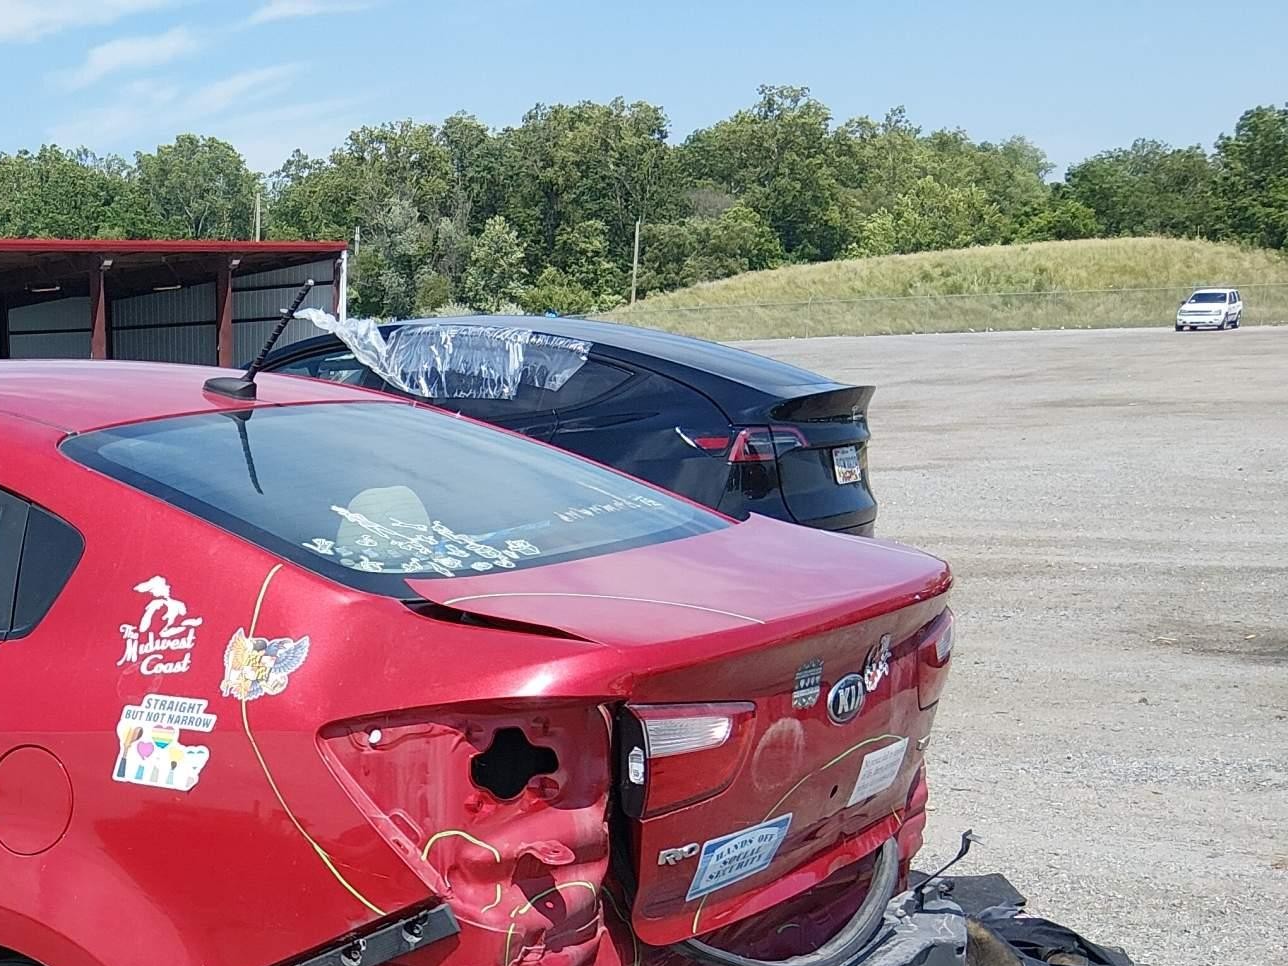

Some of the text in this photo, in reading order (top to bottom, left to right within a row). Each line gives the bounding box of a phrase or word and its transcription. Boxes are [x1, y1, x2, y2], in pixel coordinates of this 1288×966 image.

[117, 628, 196, 666] Midwest
[140, 653, 191, 676] Coast
[145, 697, 204, 714] STRAIGHT
[838, 681, 864, 715] KIA
[124, 709, 213, 729] BUT NOT NARROW
[657, 842, 700, 866] RIO
[715, 833, 775, 862] HANDS OFF
[719, 846, 763, 868] SOCIAL
[706, 853, 764, 881] SECURITY
